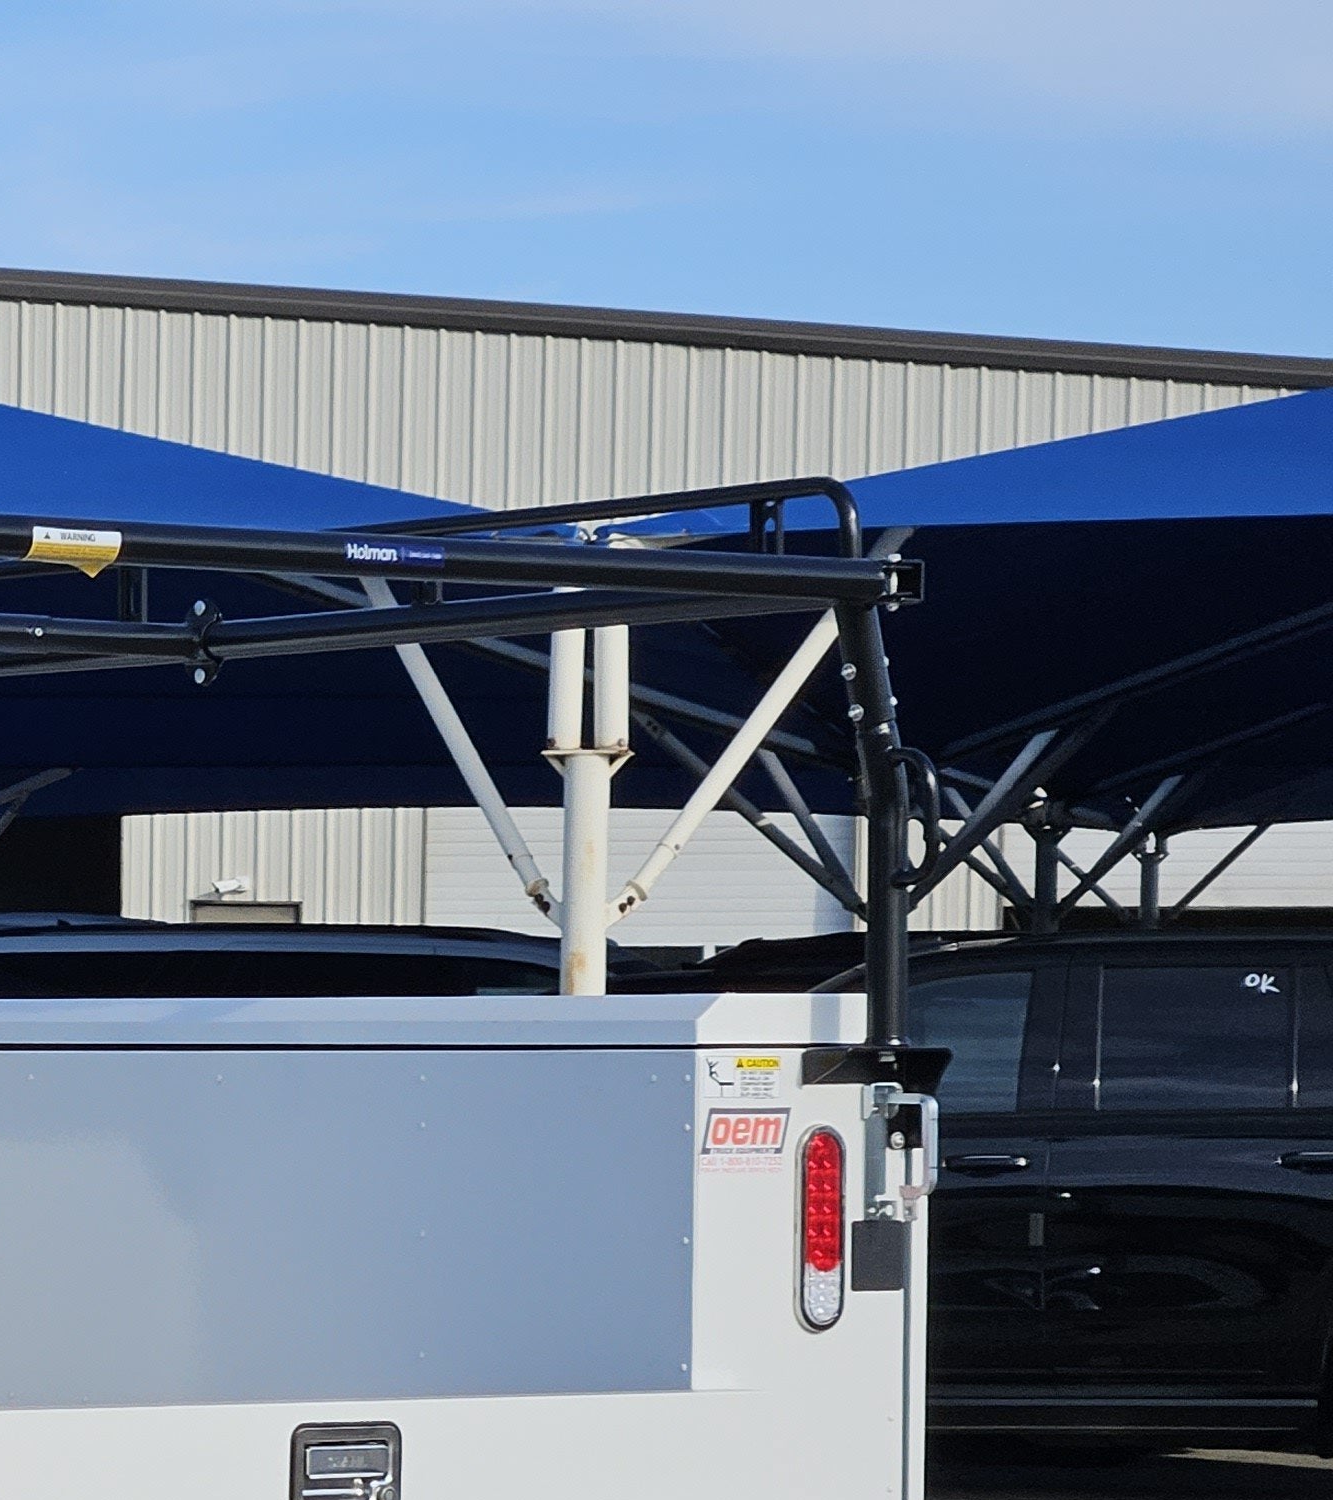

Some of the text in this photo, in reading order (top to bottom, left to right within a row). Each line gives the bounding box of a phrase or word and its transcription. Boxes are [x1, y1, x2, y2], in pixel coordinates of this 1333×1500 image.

[346, 543, 398, 562] Holman
[1244, 973, 1281, 994] OK
[745, 1058, 779, 1068] CAUTION
[711, 1116, 782, 1146] oem
